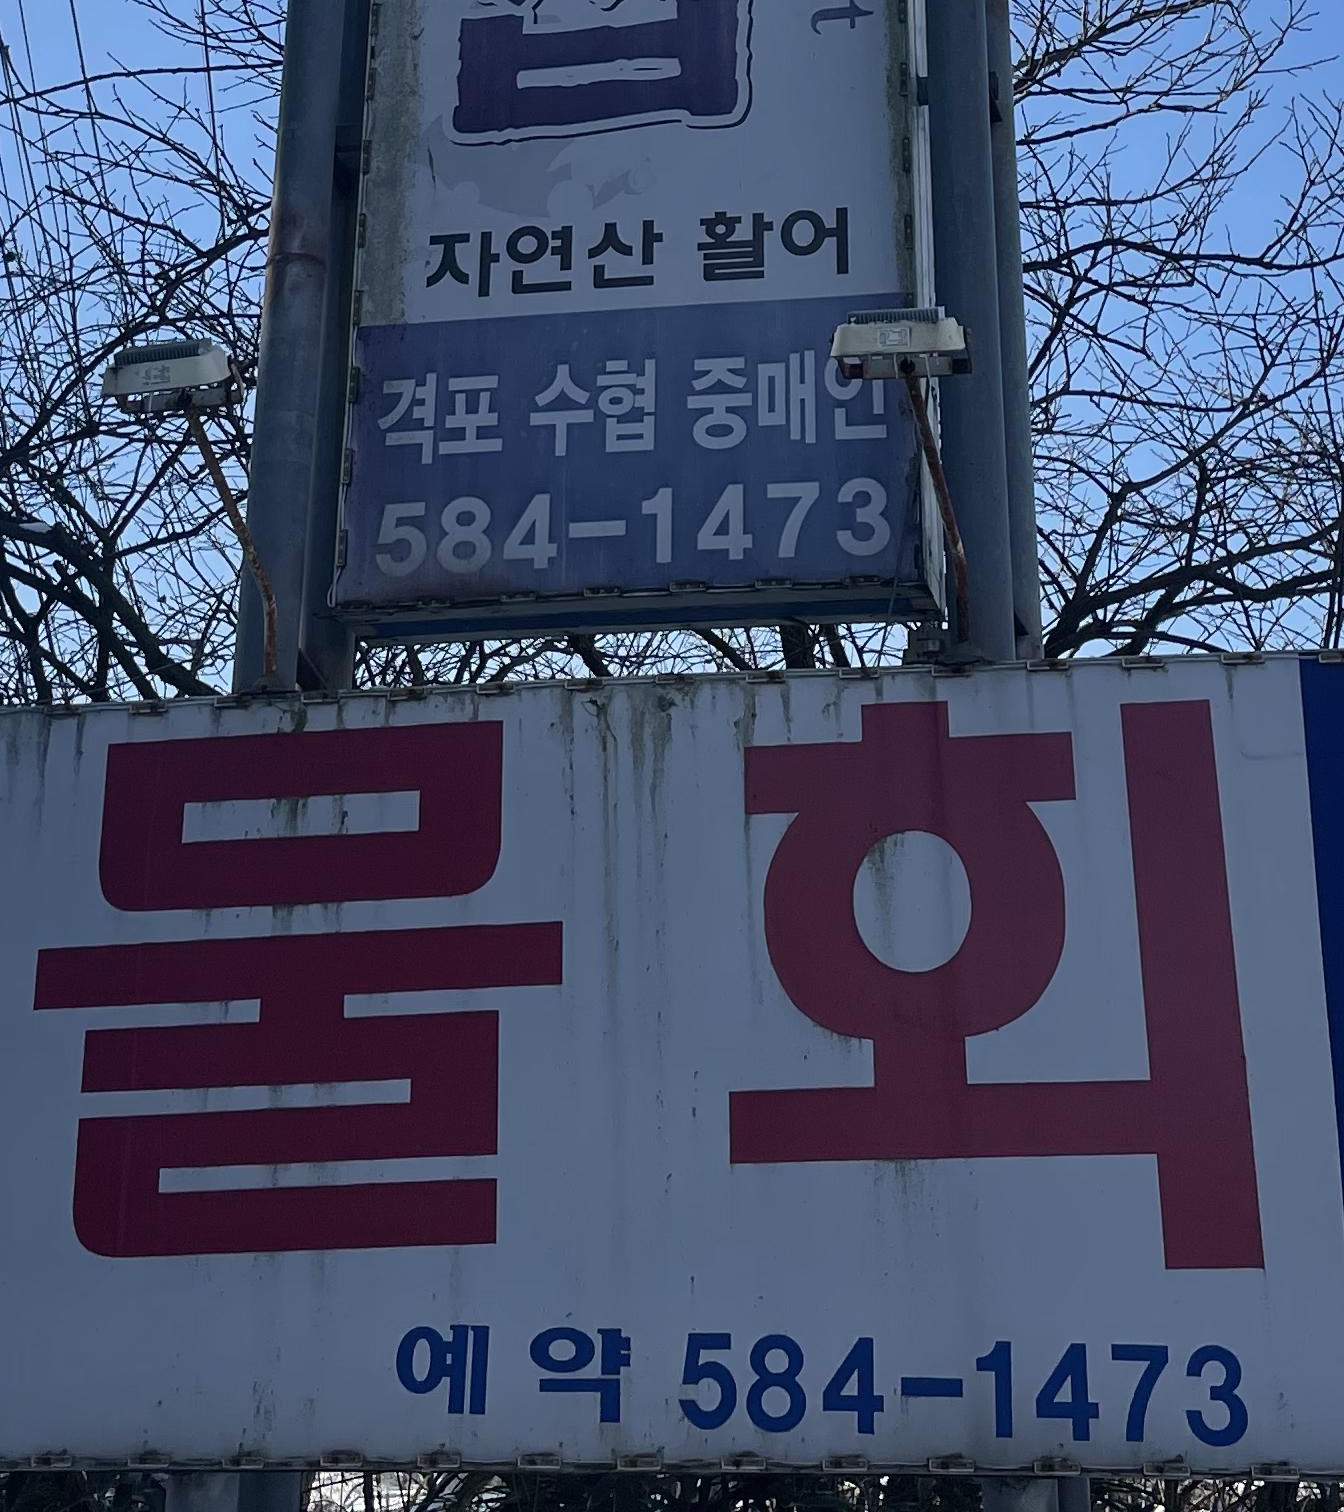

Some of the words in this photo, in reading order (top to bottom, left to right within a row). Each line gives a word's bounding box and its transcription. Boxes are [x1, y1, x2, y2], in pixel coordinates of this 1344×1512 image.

[425, 219, 665, 298] 자연산
[696, 207, 850, 282] 활어
[377, 371, 504, 465] 격포
[529, 359, 656, 457] 수협
[686, 349, 888, 450] 중매인
[374, 477, 893, 577] 584-1473
[678, 1330, 1250, 1447] 584-1473
